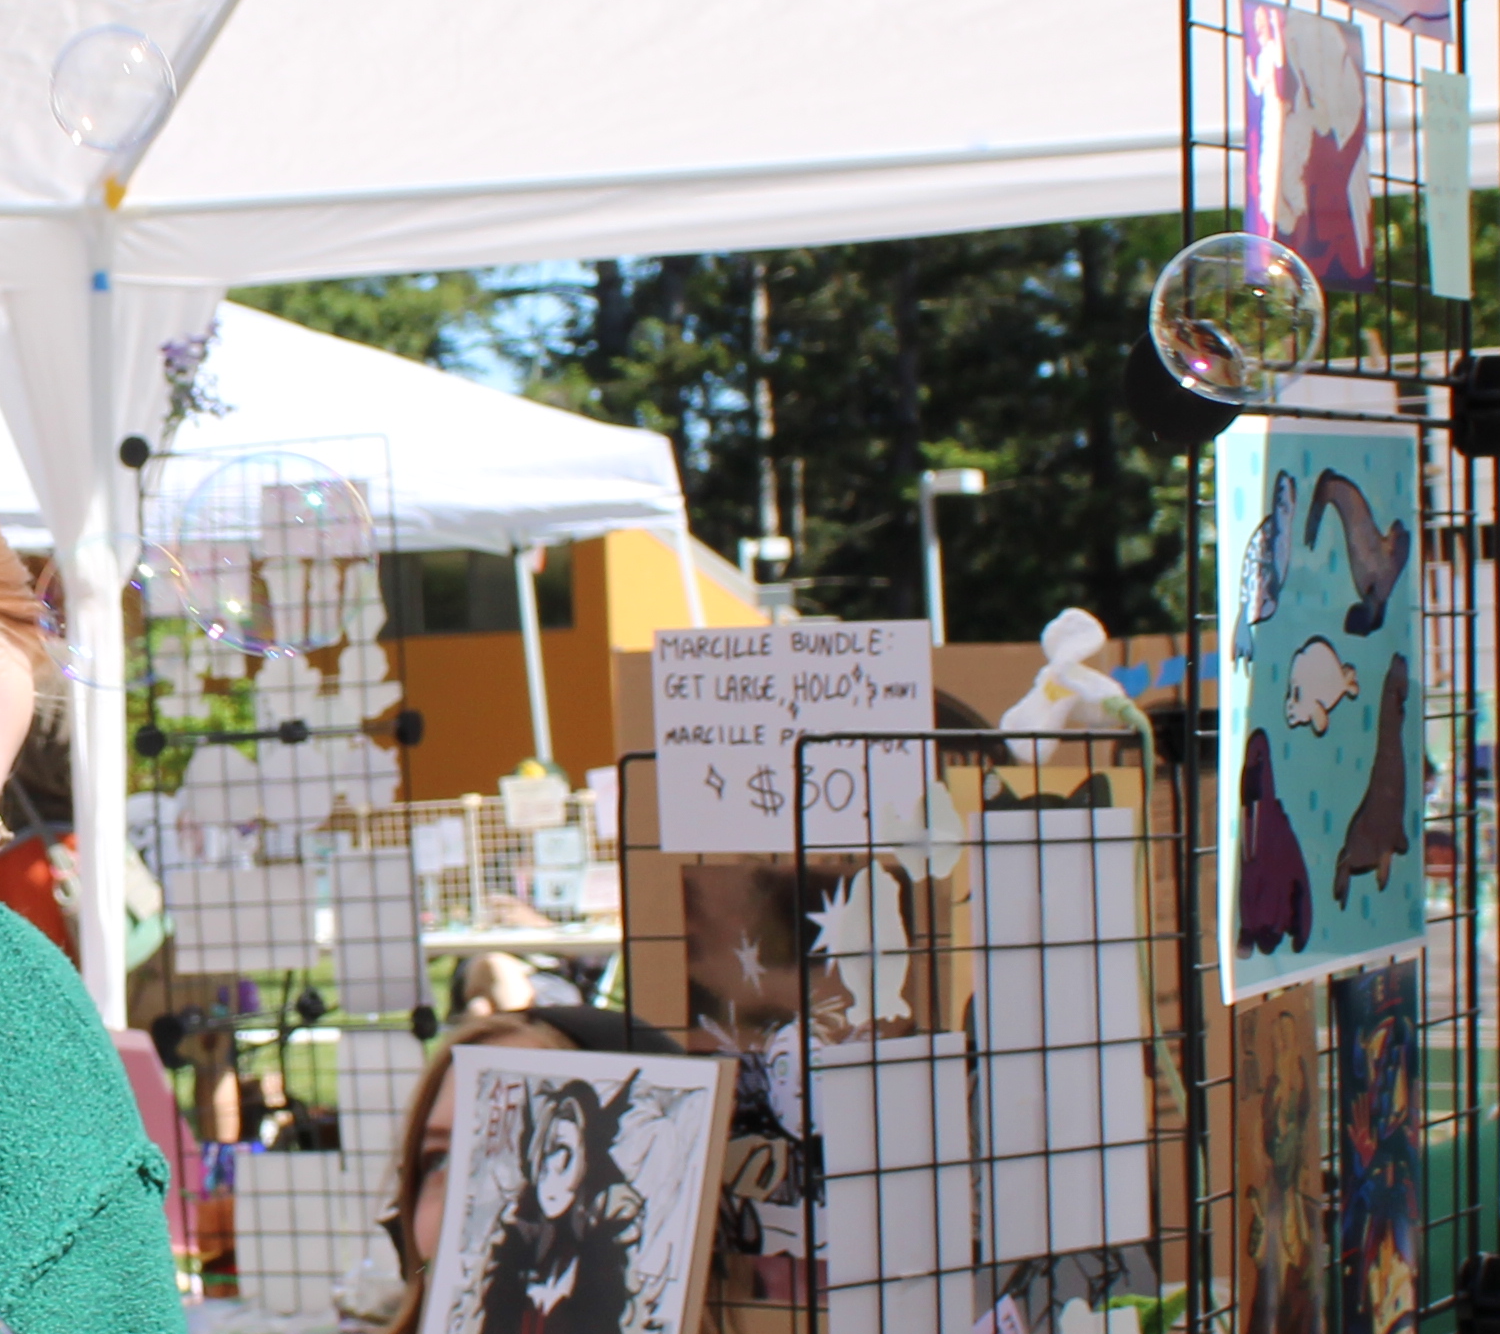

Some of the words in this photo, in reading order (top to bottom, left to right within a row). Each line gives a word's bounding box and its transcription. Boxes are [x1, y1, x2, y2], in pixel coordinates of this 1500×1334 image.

[660, 631, 773, 661] MARCILLE
[790, 628, 895, 657] BUNDLE:
[664, 672, 705, 701] GET
[664, 723, 767, 747] MARCILLE
[747, 763, 856, 817] $30
